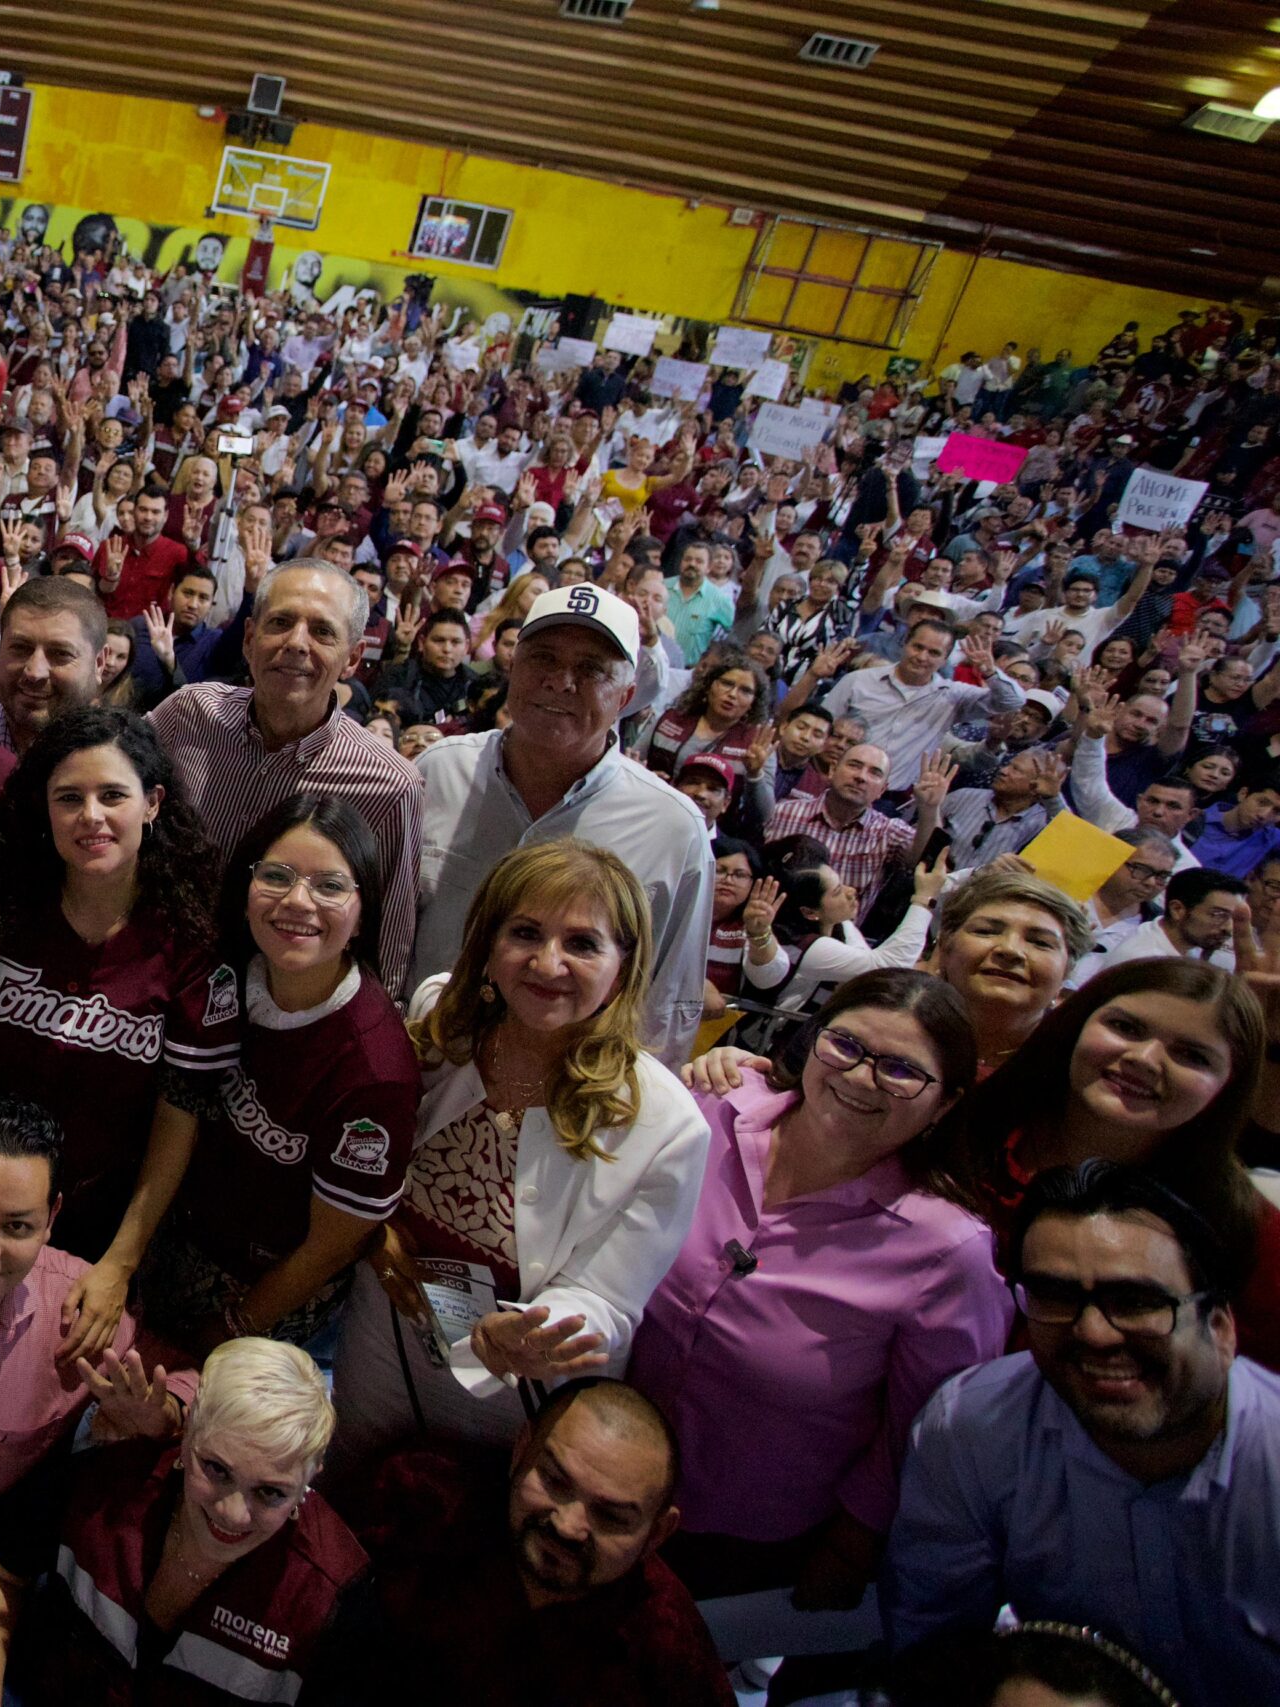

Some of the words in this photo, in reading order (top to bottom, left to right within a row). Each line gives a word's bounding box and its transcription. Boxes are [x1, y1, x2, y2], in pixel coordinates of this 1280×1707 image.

[567, 586, 599, 617] SD
[220, 1065, 310, 1165] ateros
[333, 1155, 384, 1173] CULIACAN
[424, 1261, 464, 1274] ÁLOGO
[213, 1604, 290, 1653] morena
